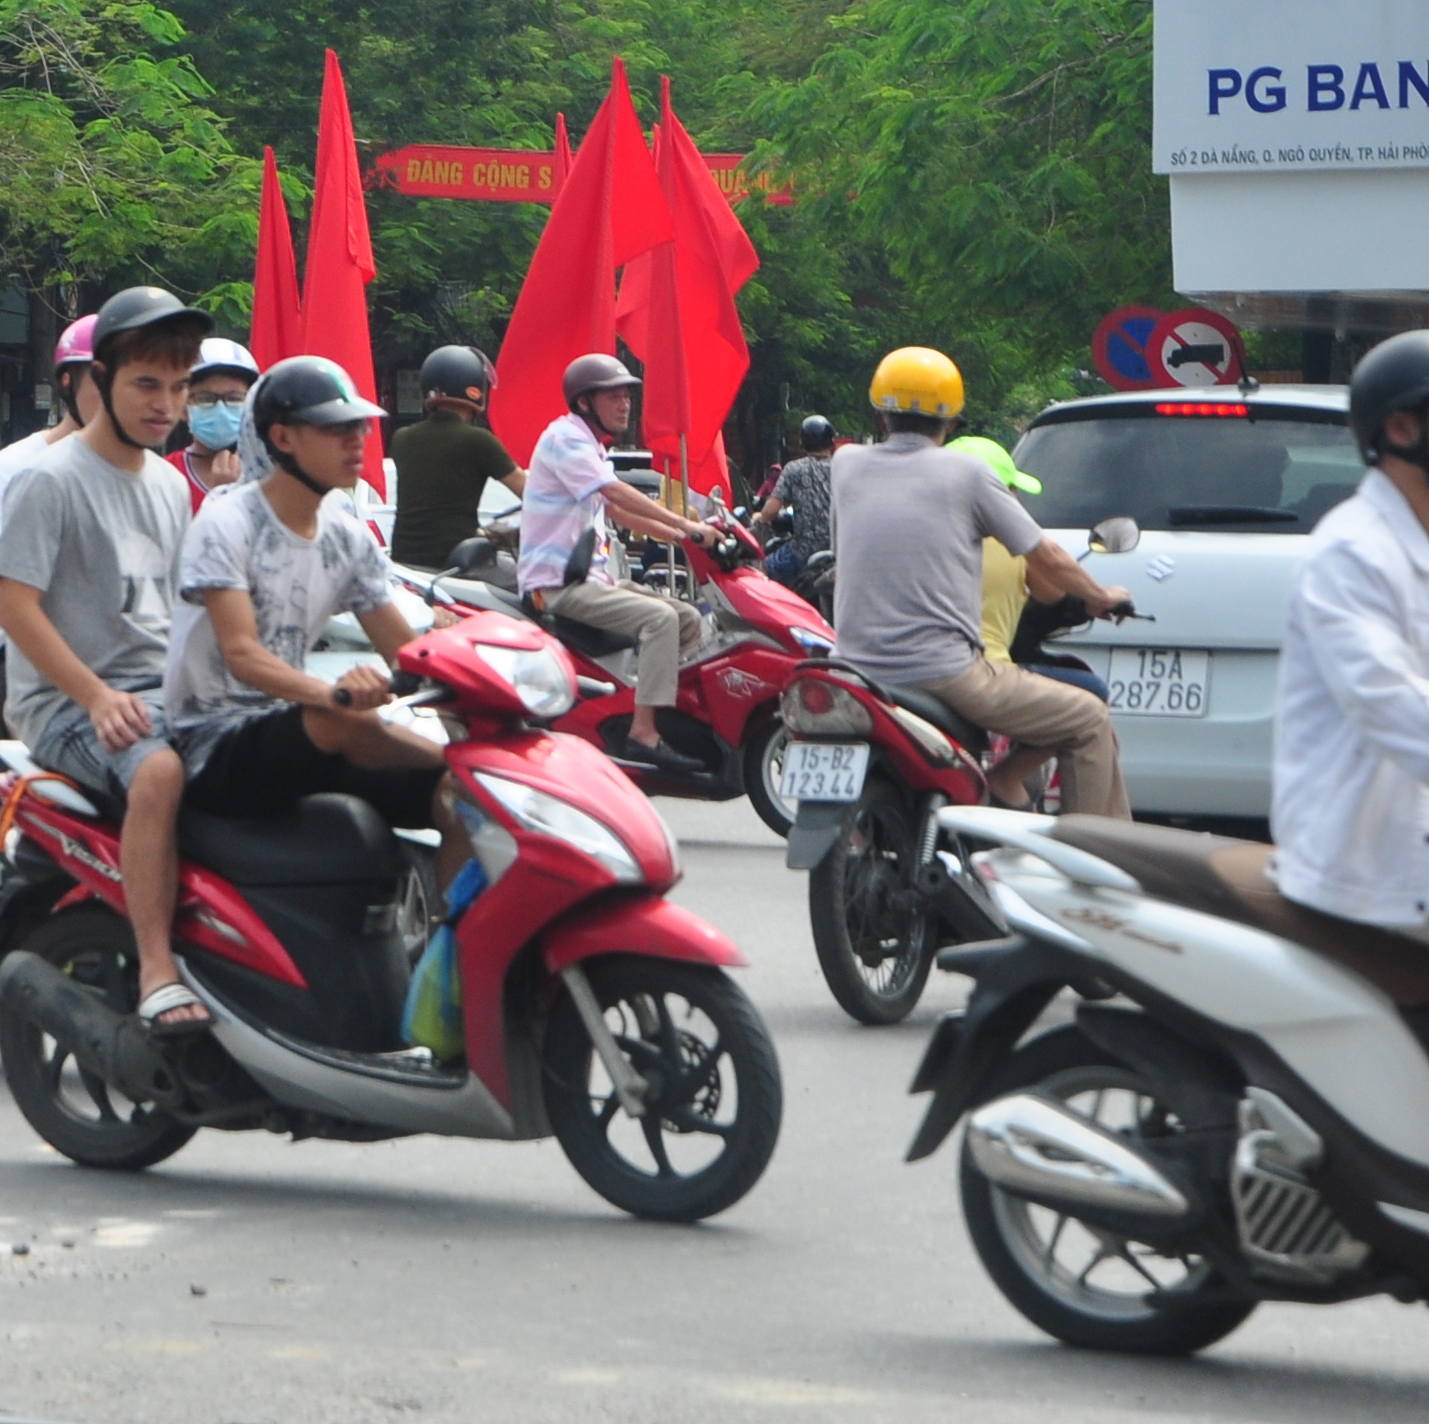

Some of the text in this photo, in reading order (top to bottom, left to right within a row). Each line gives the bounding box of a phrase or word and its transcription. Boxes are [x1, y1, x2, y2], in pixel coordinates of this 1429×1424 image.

[1207, 65, 1287, 116] PG
[1171, 146, 1187, 165] SỐ
[1190, 151, 1197, 164] 2
[1278, 145, 1305, 162] NGÔ
[1358, 146, 1374, 160] TP.
[1378, 141, 1399, 160] HẢI
[1403, 141, 1429, 158] PHÒ
[407, 159, 463, 185] ĐẢNG
[473, 160, 529, 191] CỘNG
[539, 166, 553, 189] S
[1138, 649, 1182, 680] 15A
[1110, 680, 1202, 711] 287.66
[800, 745, 855, 770] 15-B2
[789, 770, 857, 797] 123.44
